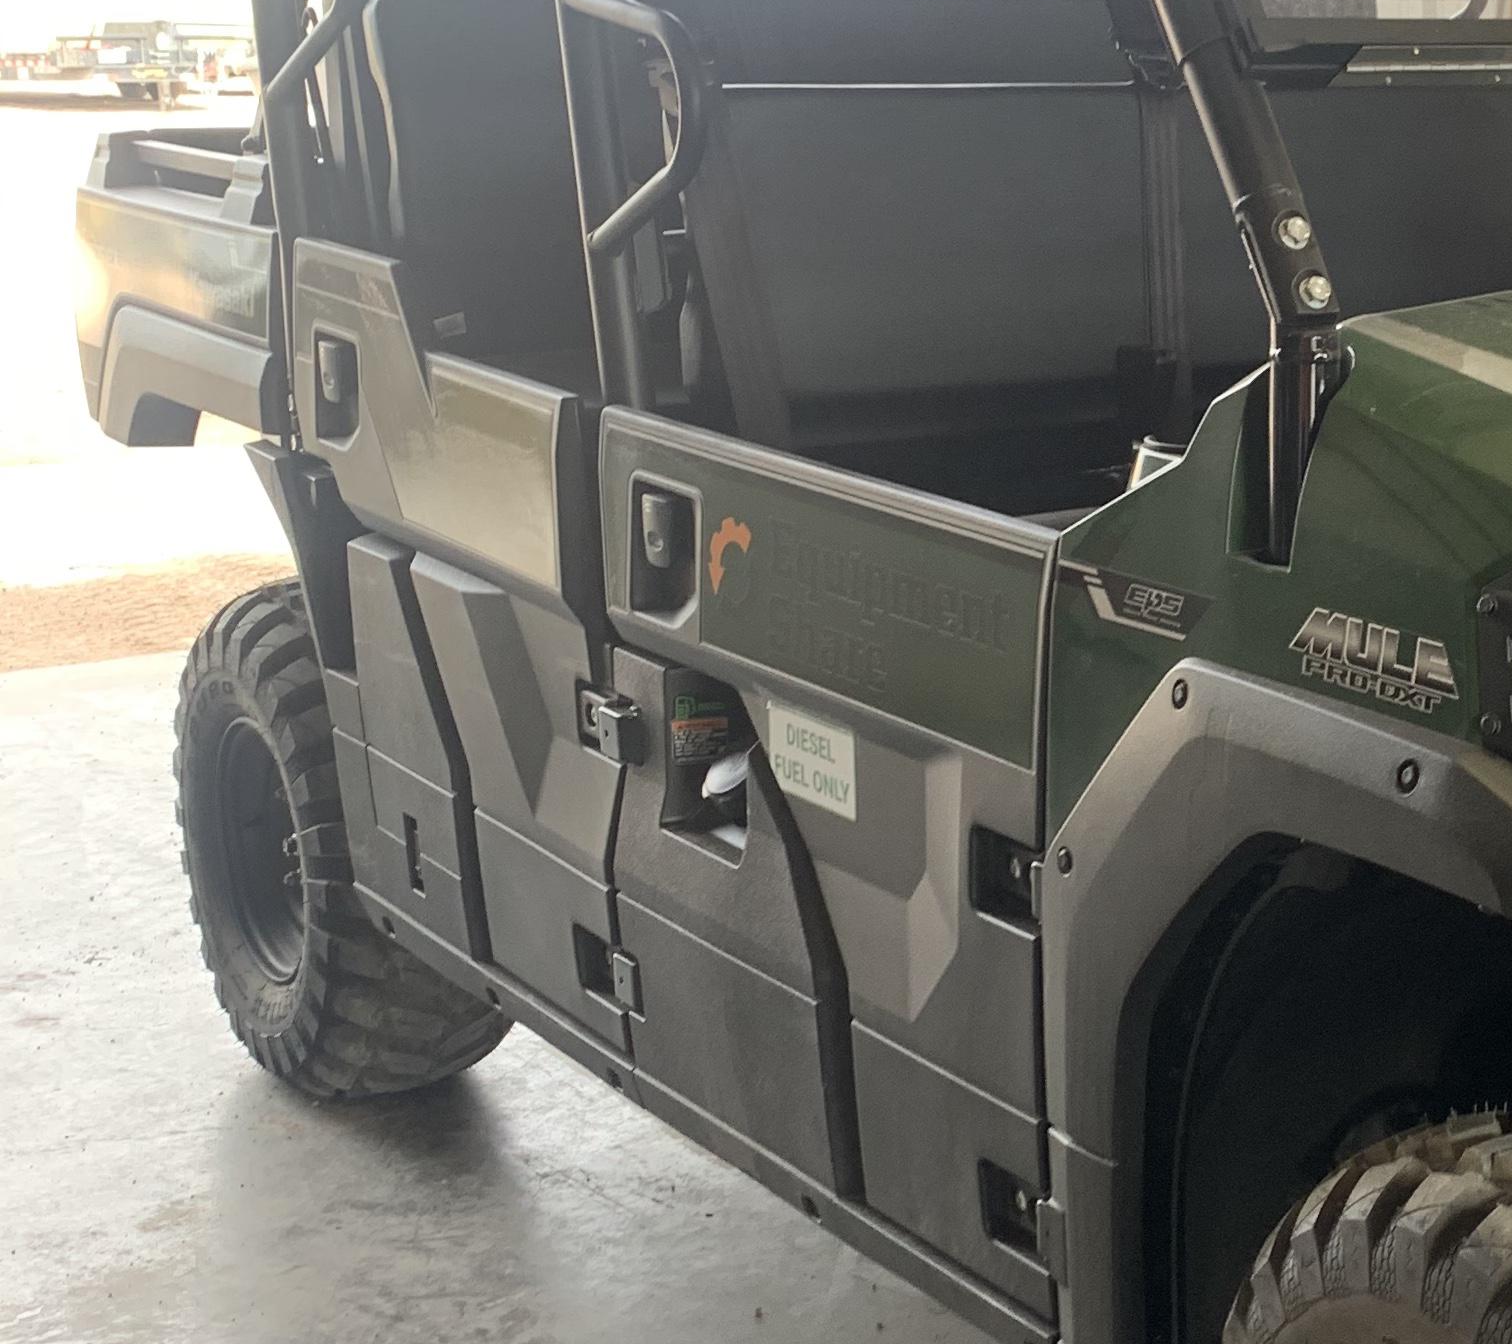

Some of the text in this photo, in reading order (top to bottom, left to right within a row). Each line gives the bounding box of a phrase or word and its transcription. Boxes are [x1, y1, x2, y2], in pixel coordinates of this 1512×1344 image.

[1288, 606, 1460, 700] MULE
[786, 723, 836, 764] DIESEL
[774, 753, 851, 805] FUEL ONLY
